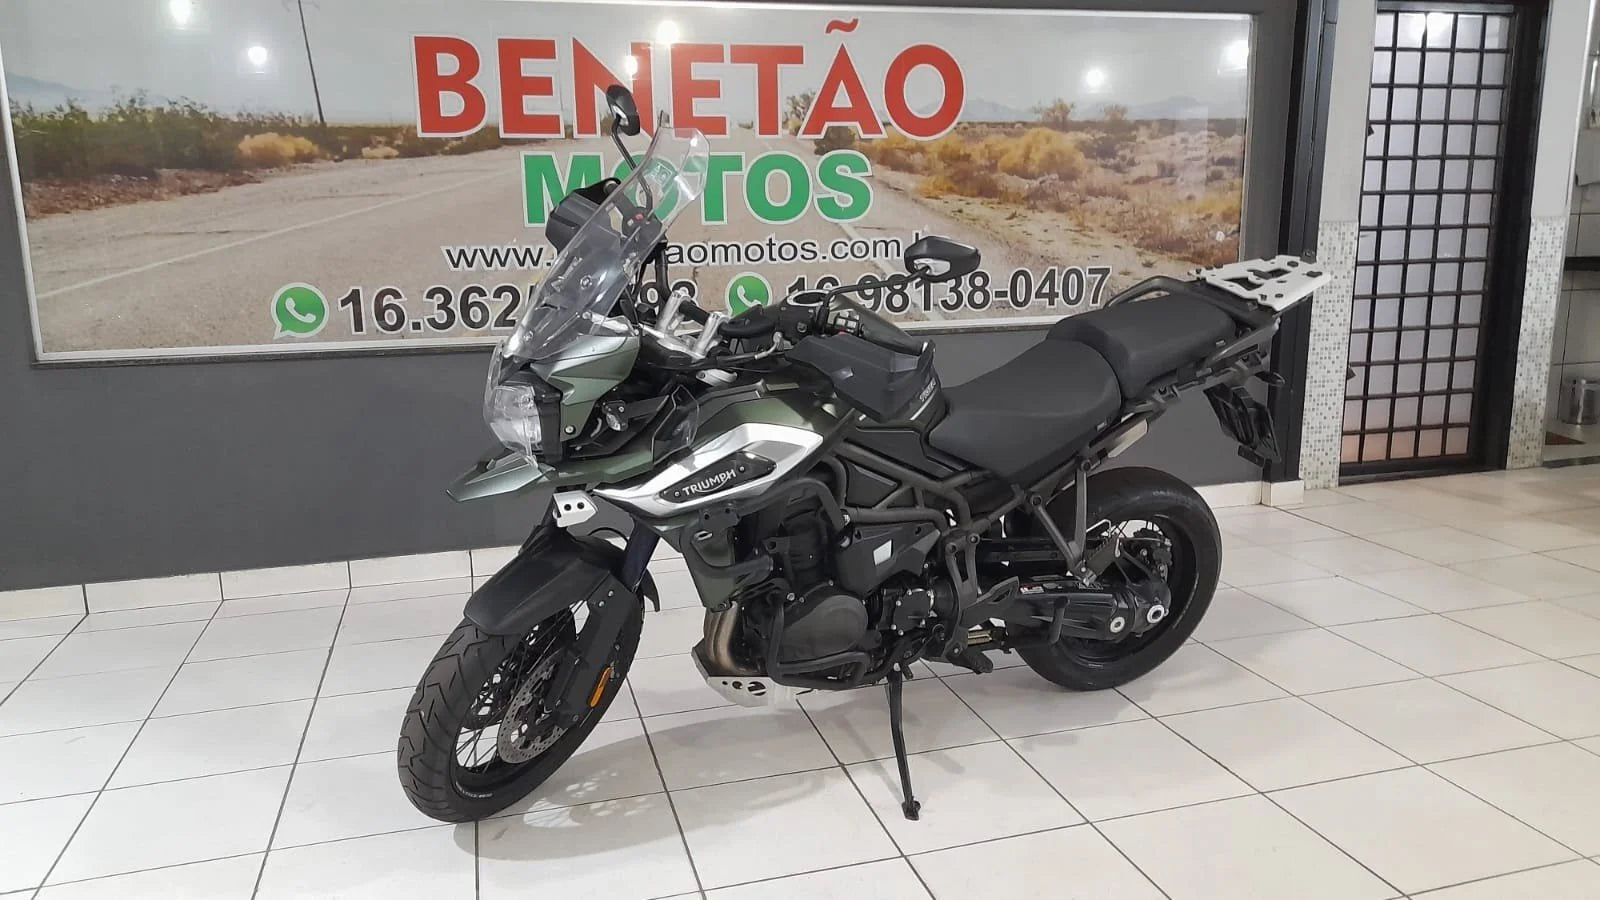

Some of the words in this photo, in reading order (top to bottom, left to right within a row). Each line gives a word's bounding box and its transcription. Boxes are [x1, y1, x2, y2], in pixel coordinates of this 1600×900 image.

[413, 18, 965, 140] BENETÃO
[522, 149, 873, 226] MOTOS
[682, 469, 737, 496] TRIUMPH
